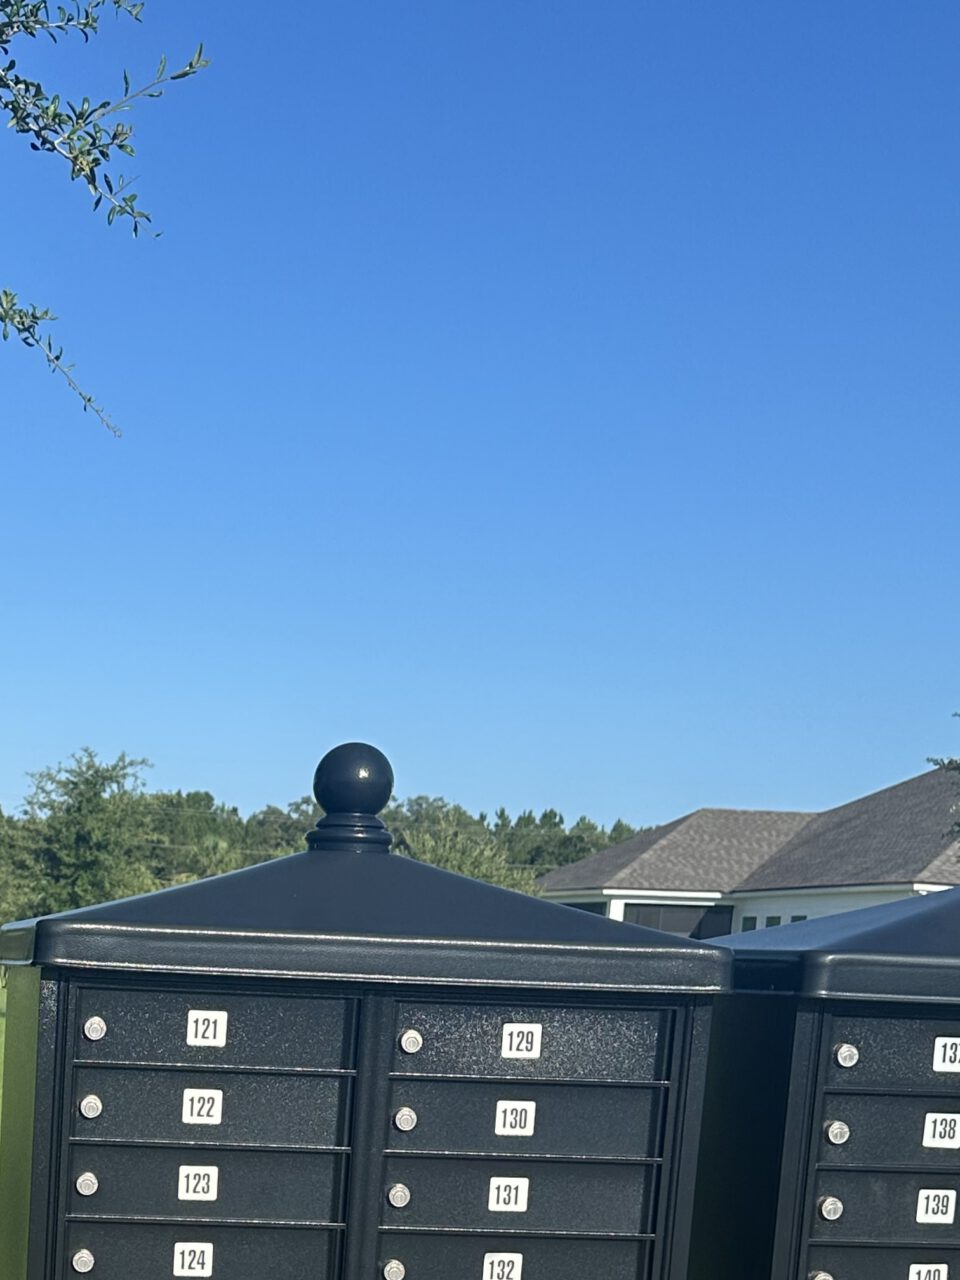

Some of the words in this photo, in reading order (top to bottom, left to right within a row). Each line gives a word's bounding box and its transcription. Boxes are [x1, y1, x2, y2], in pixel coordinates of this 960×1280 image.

[193, 1017, 218, 1040] 121
[507, 1030, 534, 1053] 129
[189, 1096, 215, 1118] 122
[501, 1107, 528, 1130] 130
[931, 1117, 957, 1140] 138
[184, 1172, 211, 1195] 123
[495, 1184, 519, 1206] 131
[924, 1194, 950, 1216] 139
[179, 1249, 206, 1271] 124
[489, 1259, 515, 1280] 132
